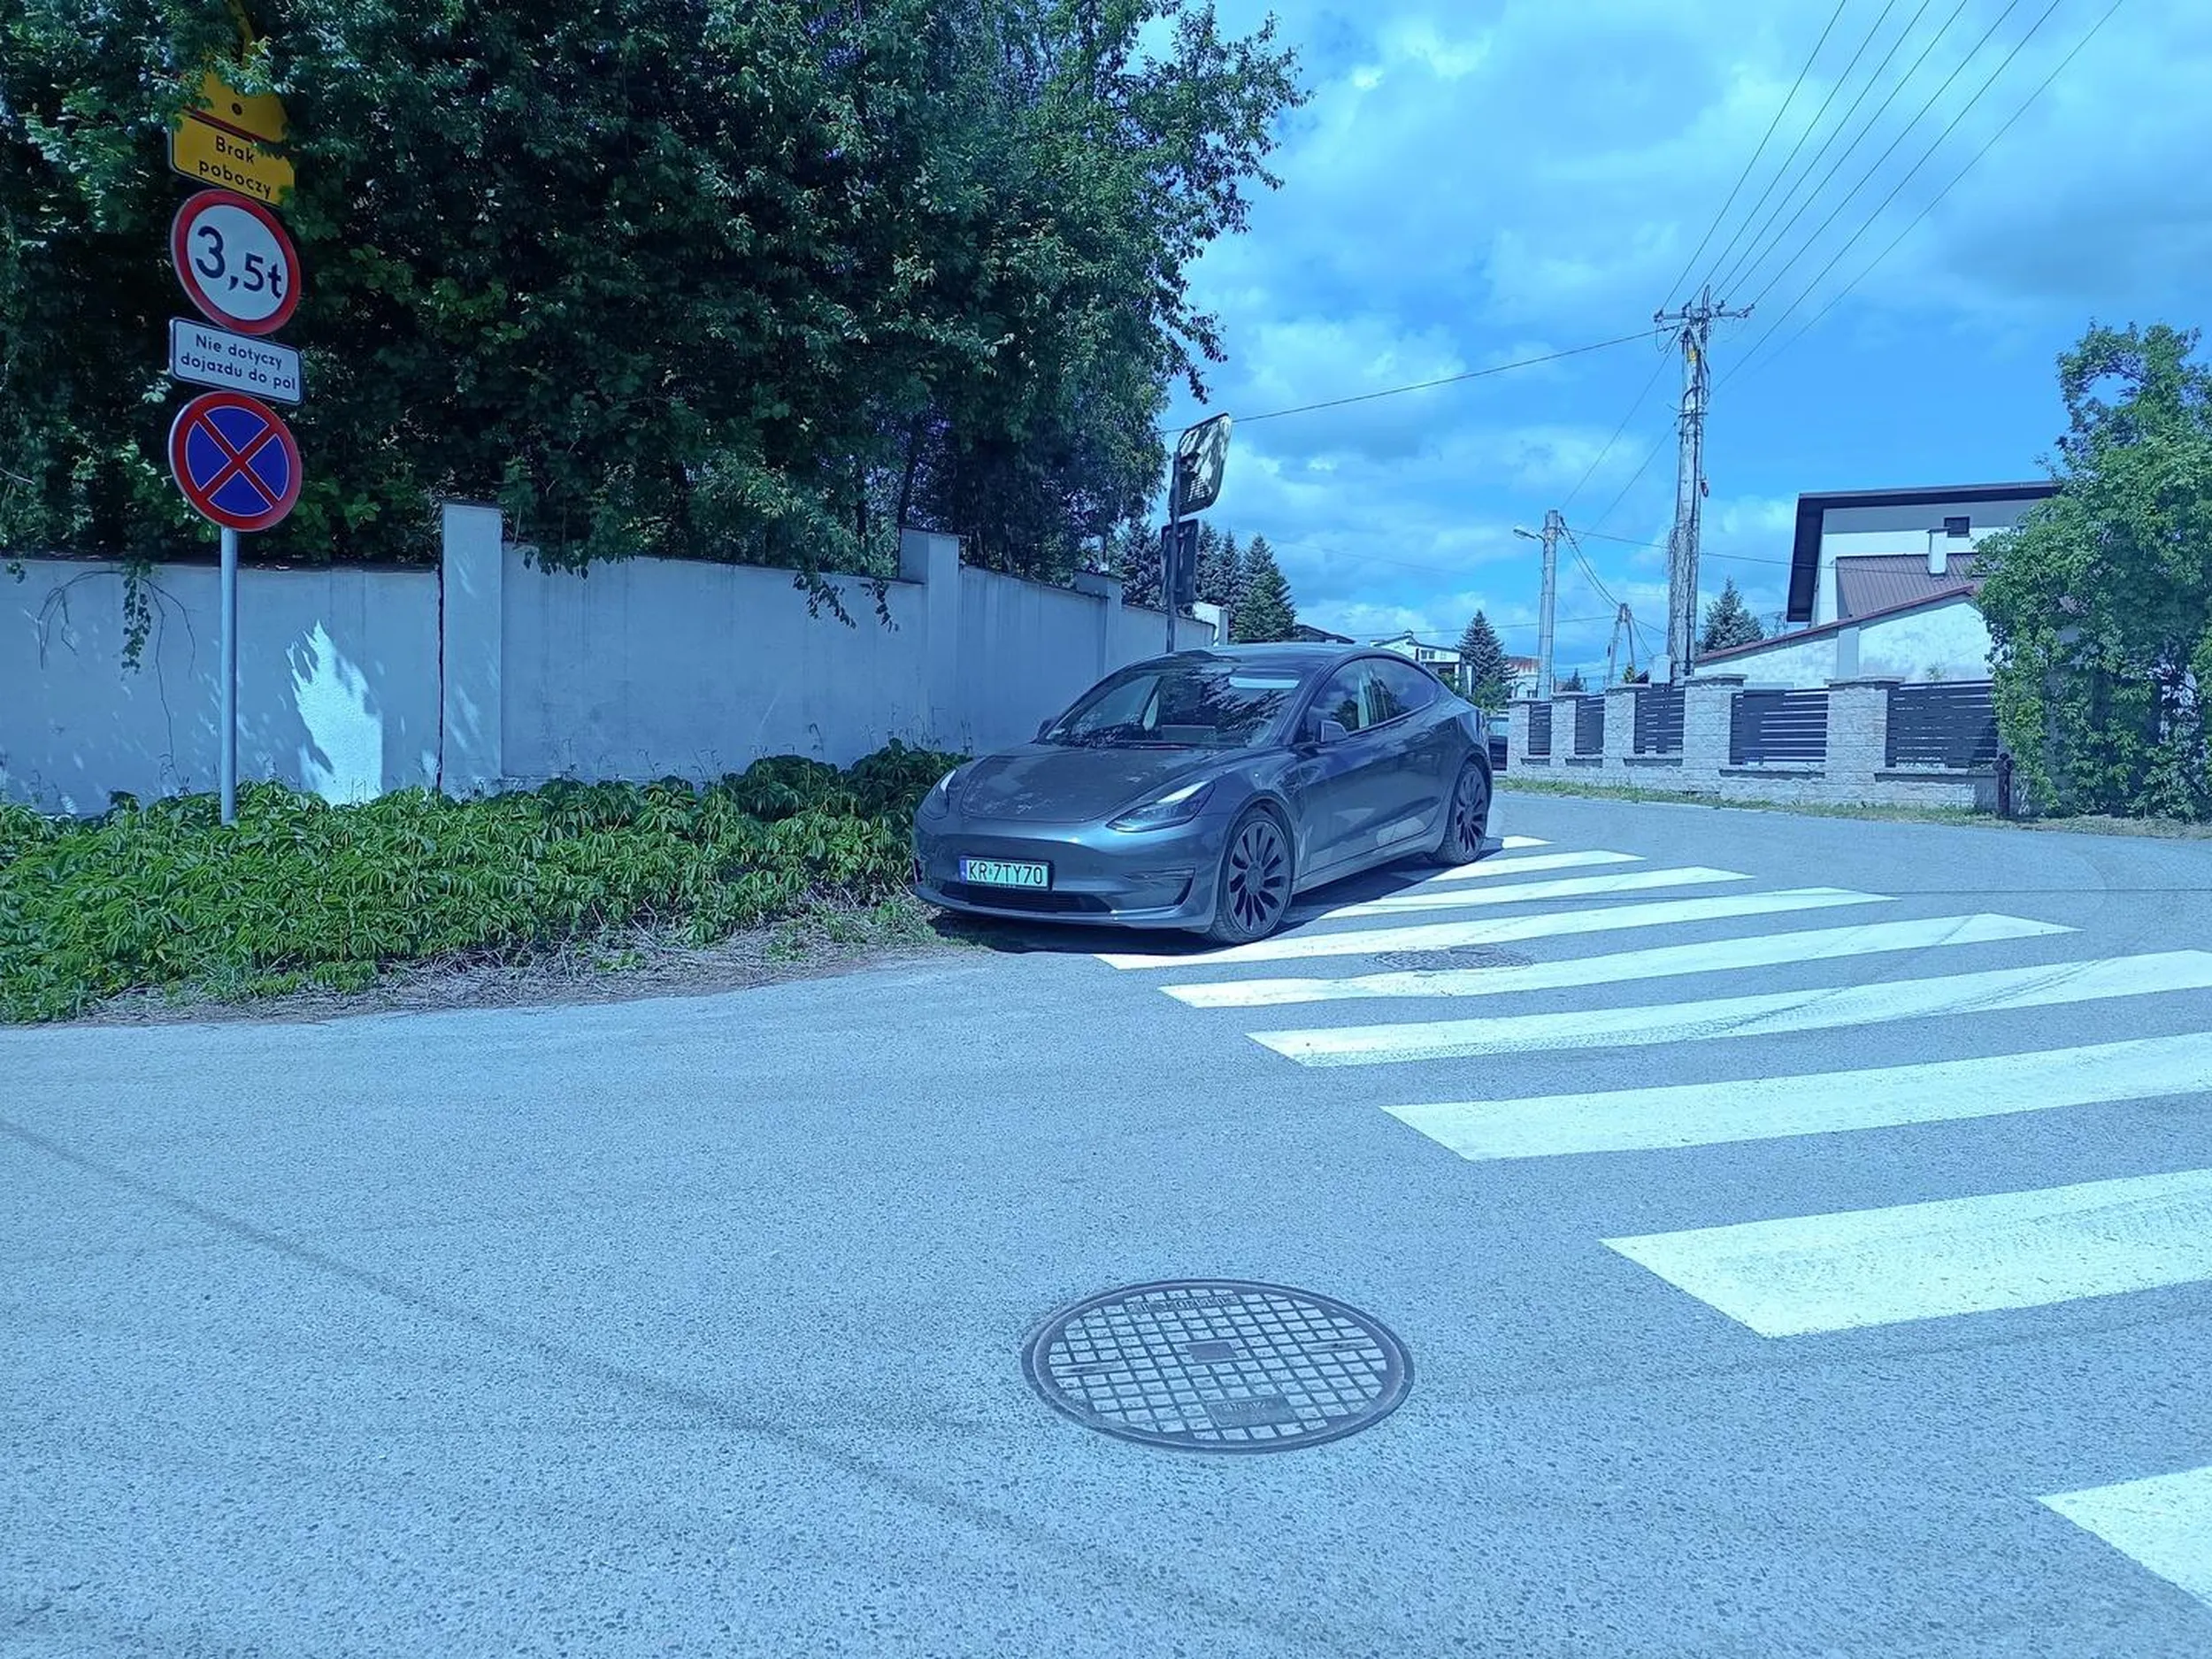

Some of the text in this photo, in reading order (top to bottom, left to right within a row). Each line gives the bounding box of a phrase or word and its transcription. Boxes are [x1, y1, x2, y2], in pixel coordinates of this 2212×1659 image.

[215, 134, 255, 164] Brak
[198, 159, 272, 200] poboczy
[195, 225, 282, 300] 3,5t
[180, 352, 242, 378] dojazdu
[248, 368, 267, 384] do
[196, 333, 282, 371] Nie dotyczy
[968, 861, 1043, 885] KR 7TY70
